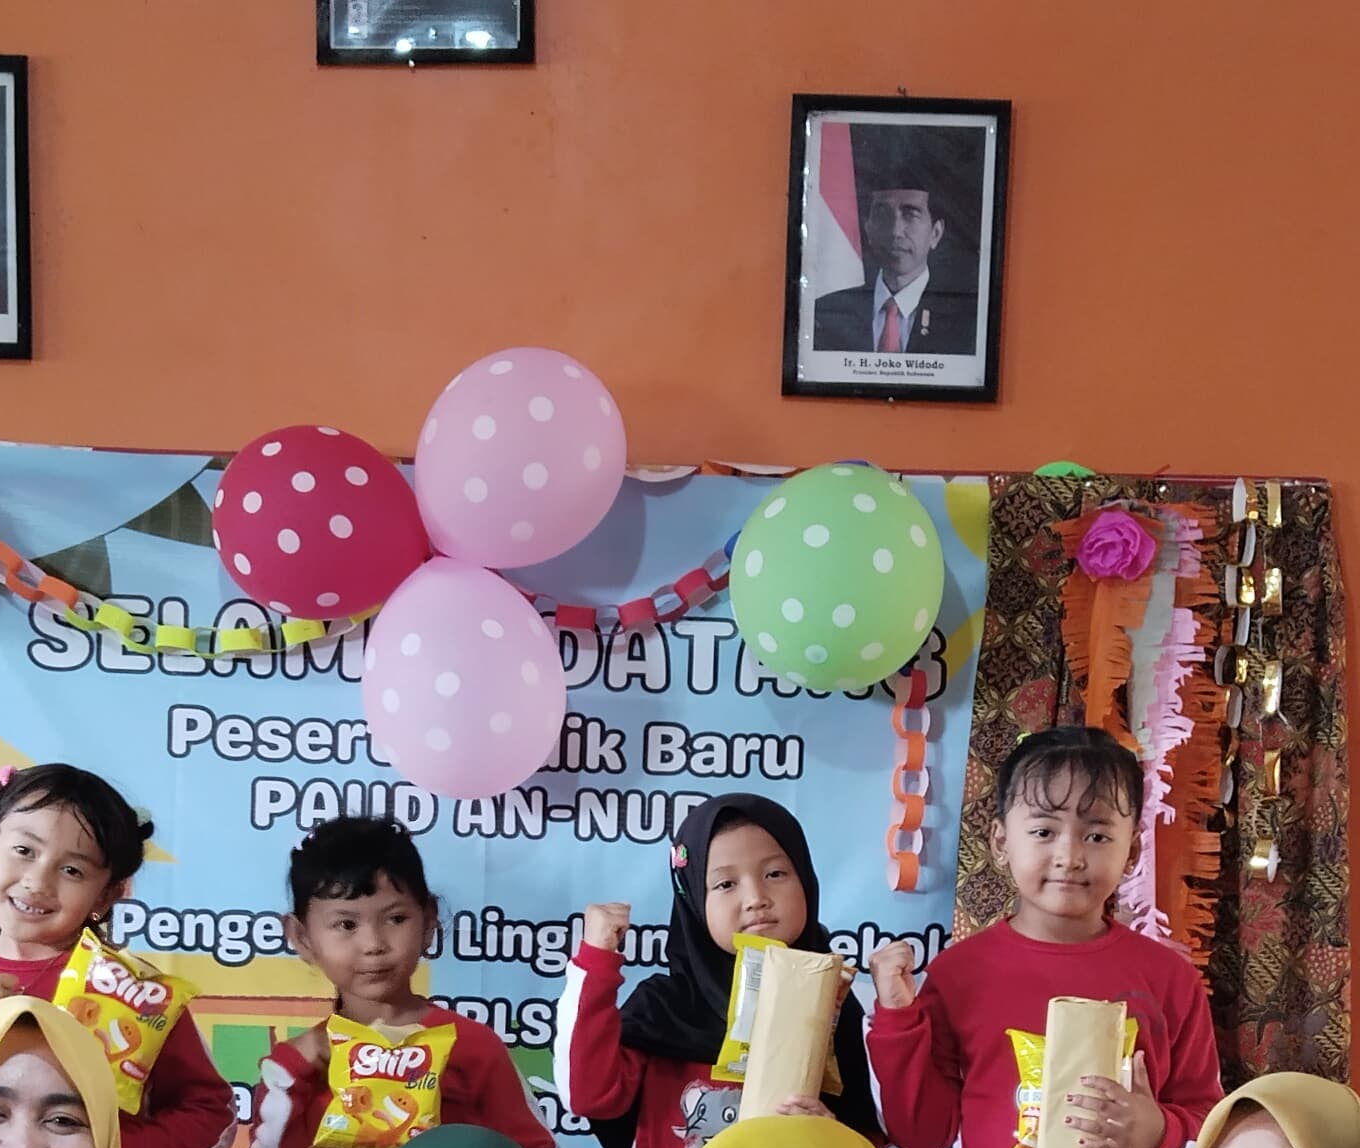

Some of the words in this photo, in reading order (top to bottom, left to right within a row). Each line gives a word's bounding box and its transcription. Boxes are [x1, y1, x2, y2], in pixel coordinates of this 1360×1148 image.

[843, 357, 856, 367] Ir.
[860, 358, 872, 368] H.
[874, 358, 902, 369] Joko
[905, 359, 945, 370] Widodo
[26, 594, 364, 683] SELAM
[552, 612, 948, 700] DAT
[167, 703, 392, 767] Pesert
[642, 720, 805, 779] Baru
[250, 775, 439, 835] PAUD
